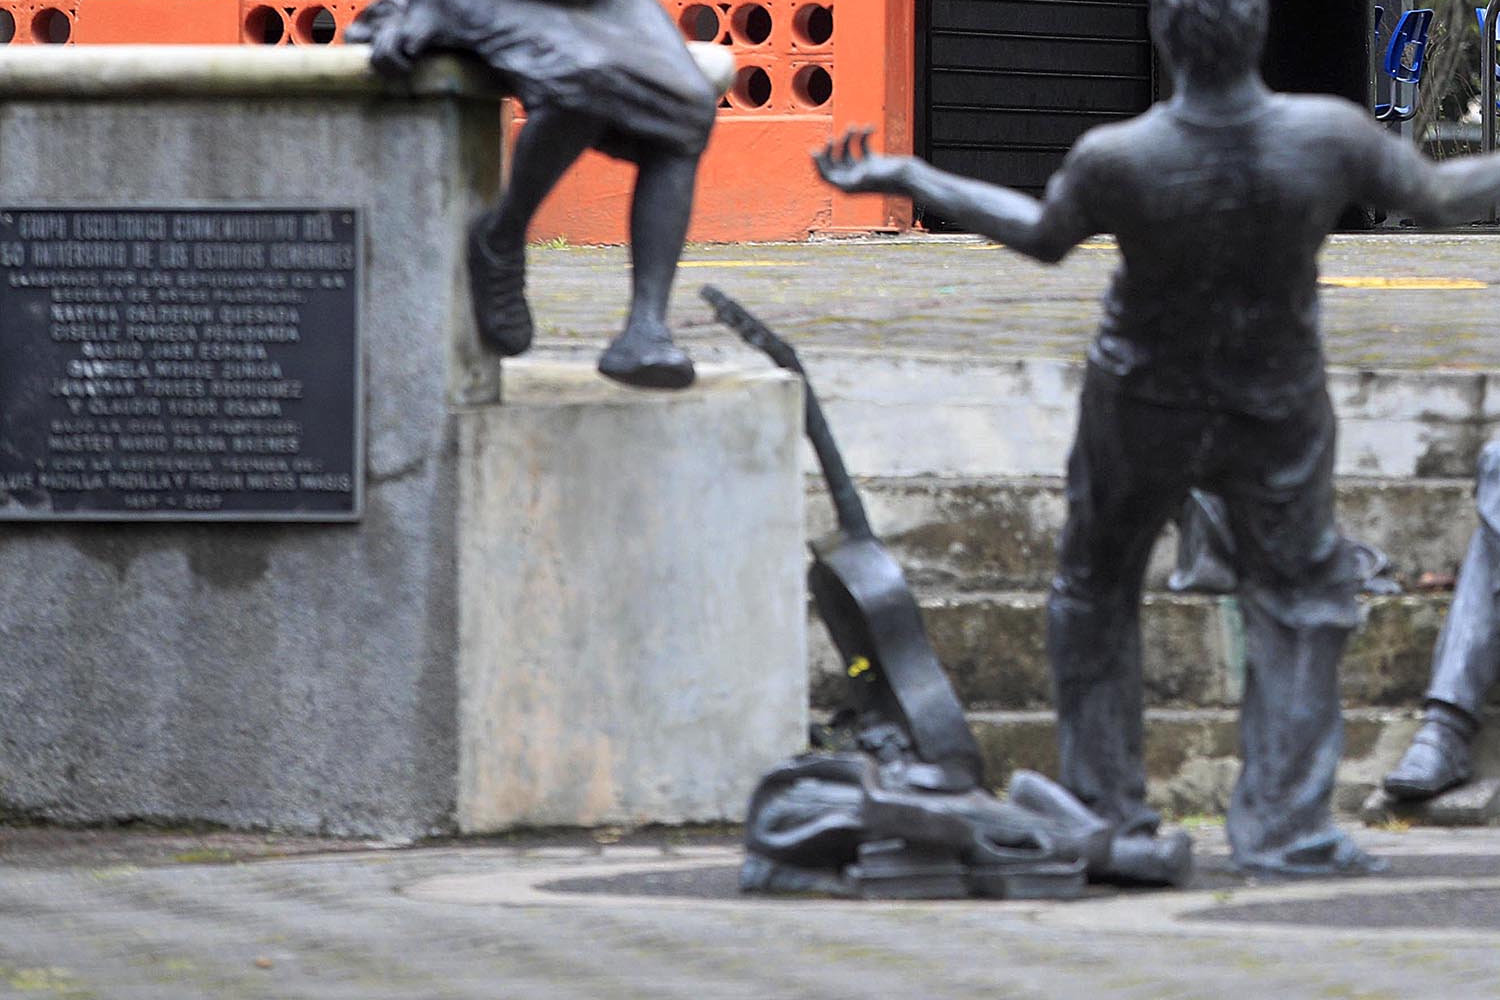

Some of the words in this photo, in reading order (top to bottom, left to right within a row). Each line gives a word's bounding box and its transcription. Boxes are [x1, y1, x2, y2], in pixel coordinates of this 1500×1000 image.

[20, 214, 66, 238] GRUPO
[32, 243, 125, 268] ANIVERSARIO
[133, 243, 154, 268] DE
[162, 243, 188, 268] LOS
[196, 243, 264, 268] ESTUDIOS
[105, 273, 135, 286] POR
[143, 273, 171, 286] LOS
[178, 273, 286, 286] ESTUDIANTES
[293, 273, 315, 286] DE
[52, 290, 122, 302] ESCUELA
[129, 290, 150, 302] DE
[158, 290, 207, 302] ARTES
[220, 306, 299, 324] QUESADA
[51, 325, 120, 341] GISELLE
[128, 325, 197, 341] FONSECA
[143, 381, 204, 397] TORRES
[100, 422, 120, 433] LA
[173, 422, 204, 433] DEL
[120, 436, 167, 452] MARIO
[93, 459, 112, 470] LA
